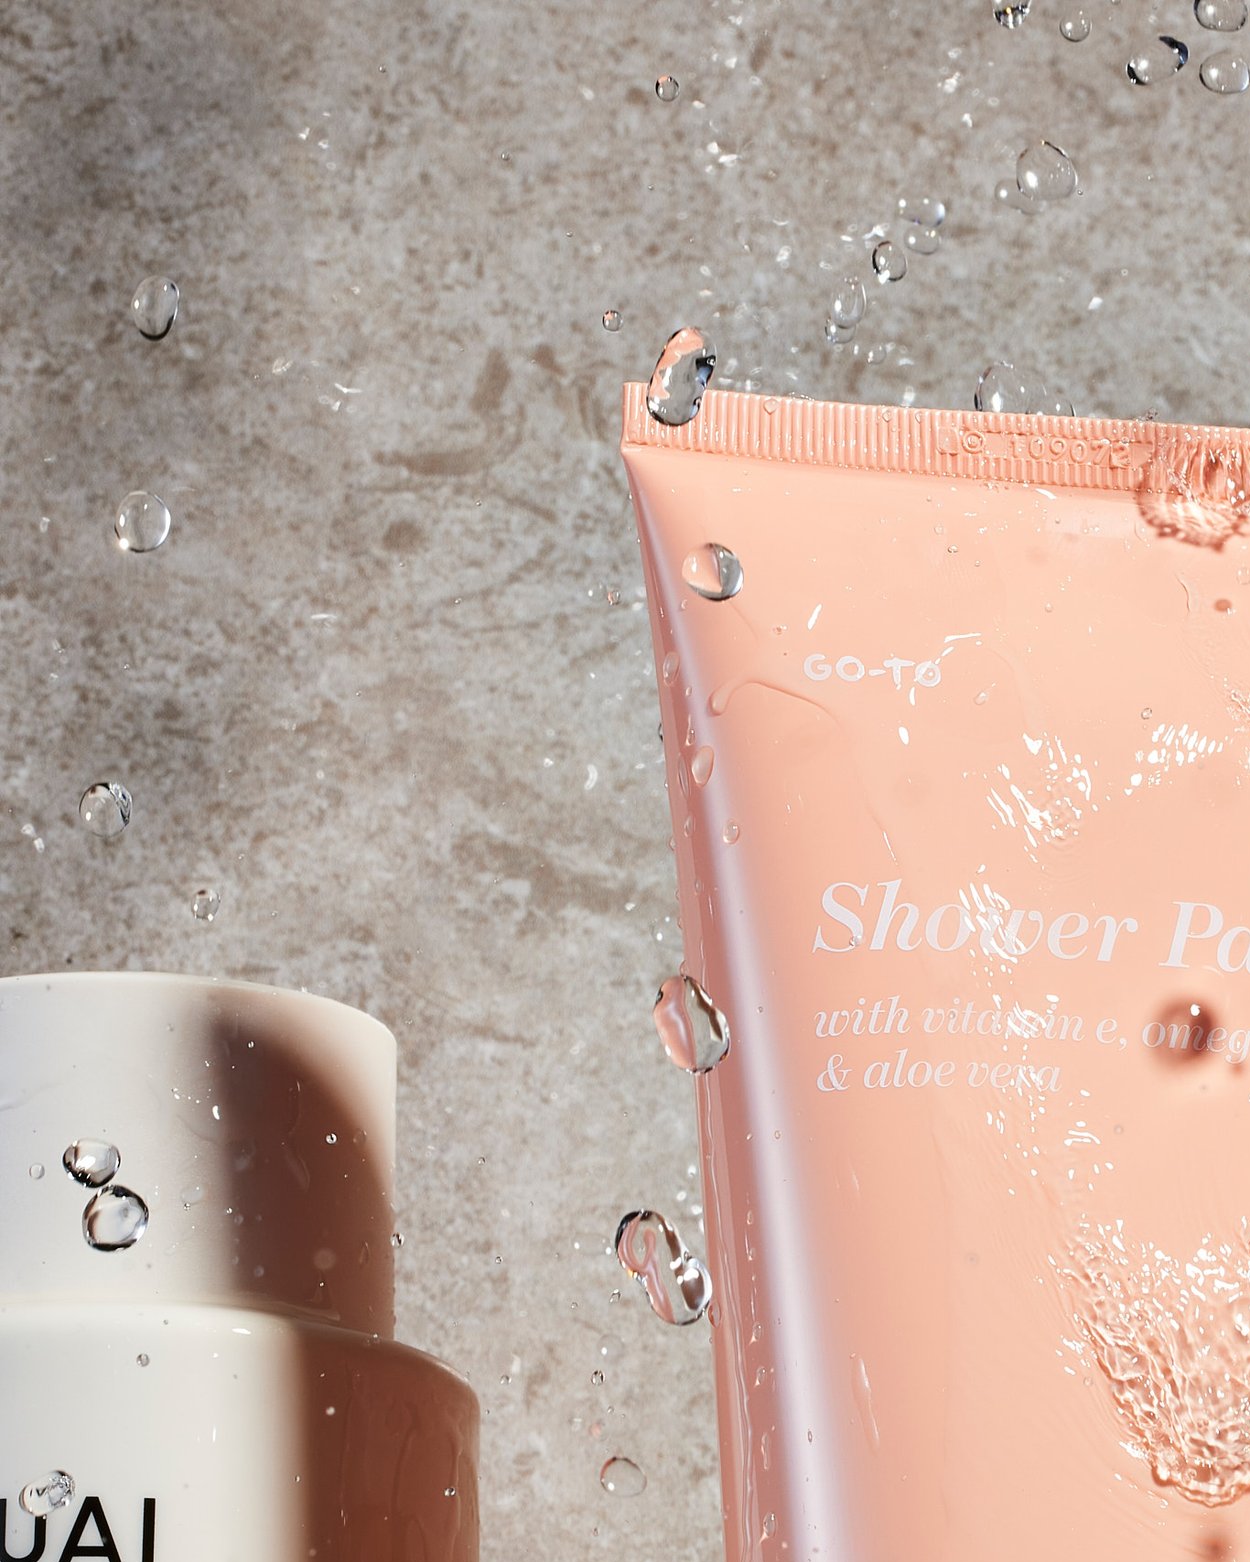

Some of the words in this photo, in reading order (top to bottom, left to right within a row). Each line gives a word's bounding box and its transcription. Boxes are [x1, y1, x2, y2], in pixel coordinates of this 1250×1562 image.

[803, 653, 942, 689] GO-TO
[812, 878, 1138, 963] Shower
[814, 995, 911, 1038] with
[1096, 1017, 1127, 1050] e,
[816, 1054, 852, 1092] &
[863, 1048, 955, 1088] aloe
[966, 1061, 1063, 1093] vera
